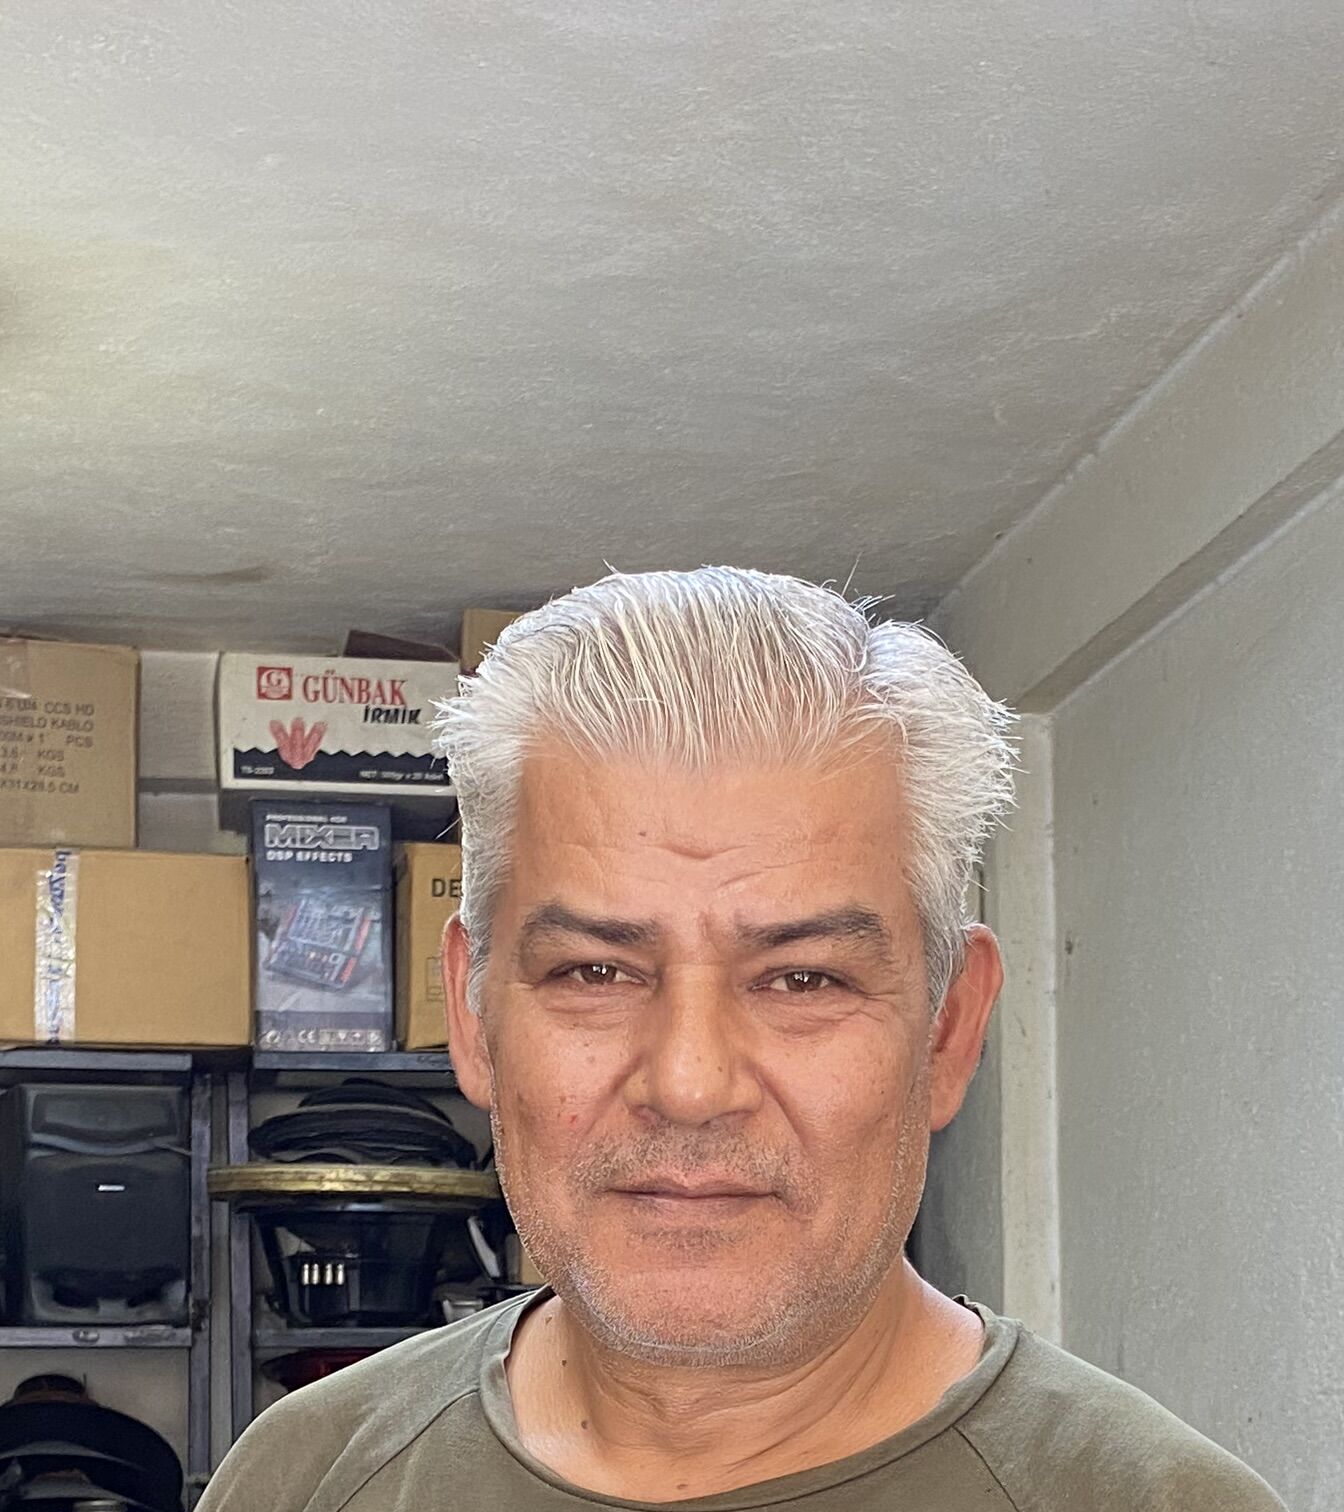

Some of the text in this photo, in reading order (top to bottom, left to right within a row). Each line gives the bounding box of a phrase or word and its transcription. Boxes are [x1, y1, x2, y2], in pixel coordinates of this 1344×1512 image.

[302, 669, 408, 706] GÜNBAK
[263, 823, 380, 850] MIXER
[266, 850, 353, 862] DSP EFFECTS
